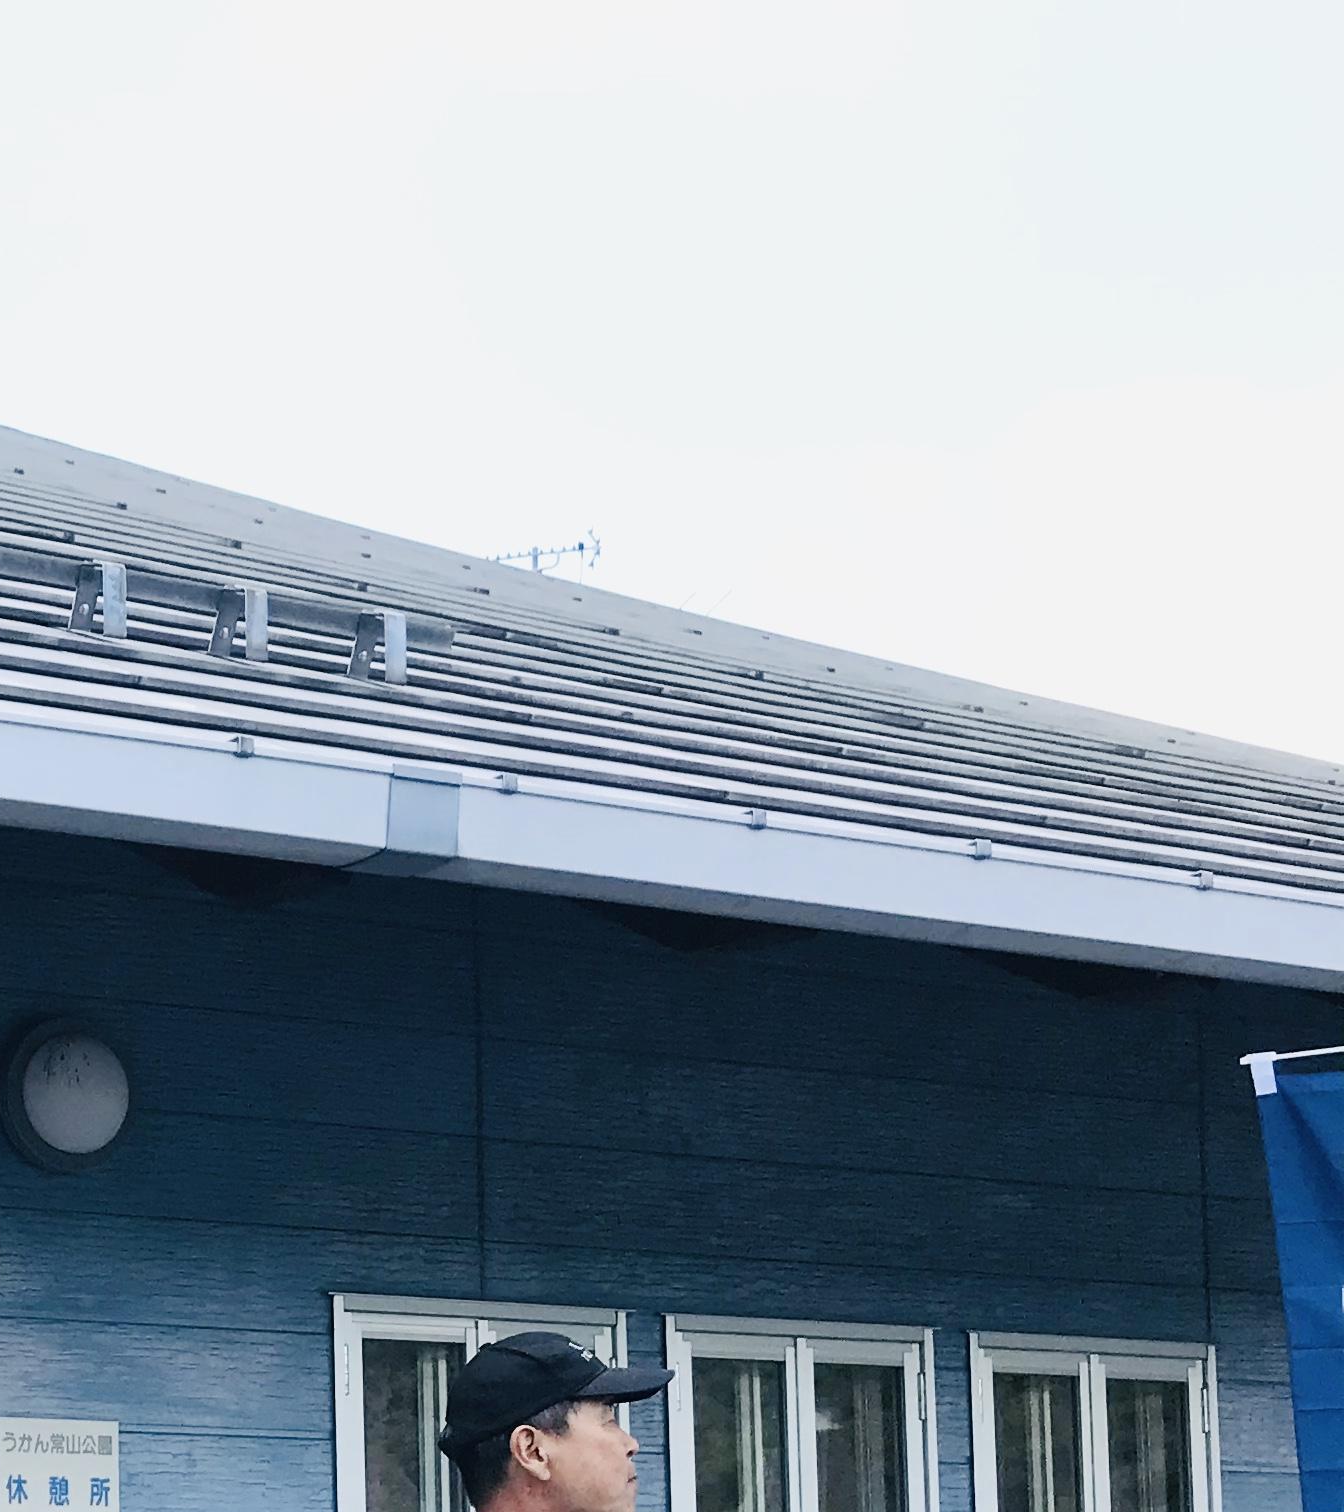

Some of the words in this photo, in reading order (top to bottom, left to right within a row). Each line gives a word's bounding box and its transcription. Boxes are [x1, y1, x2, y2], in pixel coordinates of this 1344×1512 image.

[1, 1431, 113, 1455] うかん常山公園
[5, 1473, 111, 1507] 休憩所
